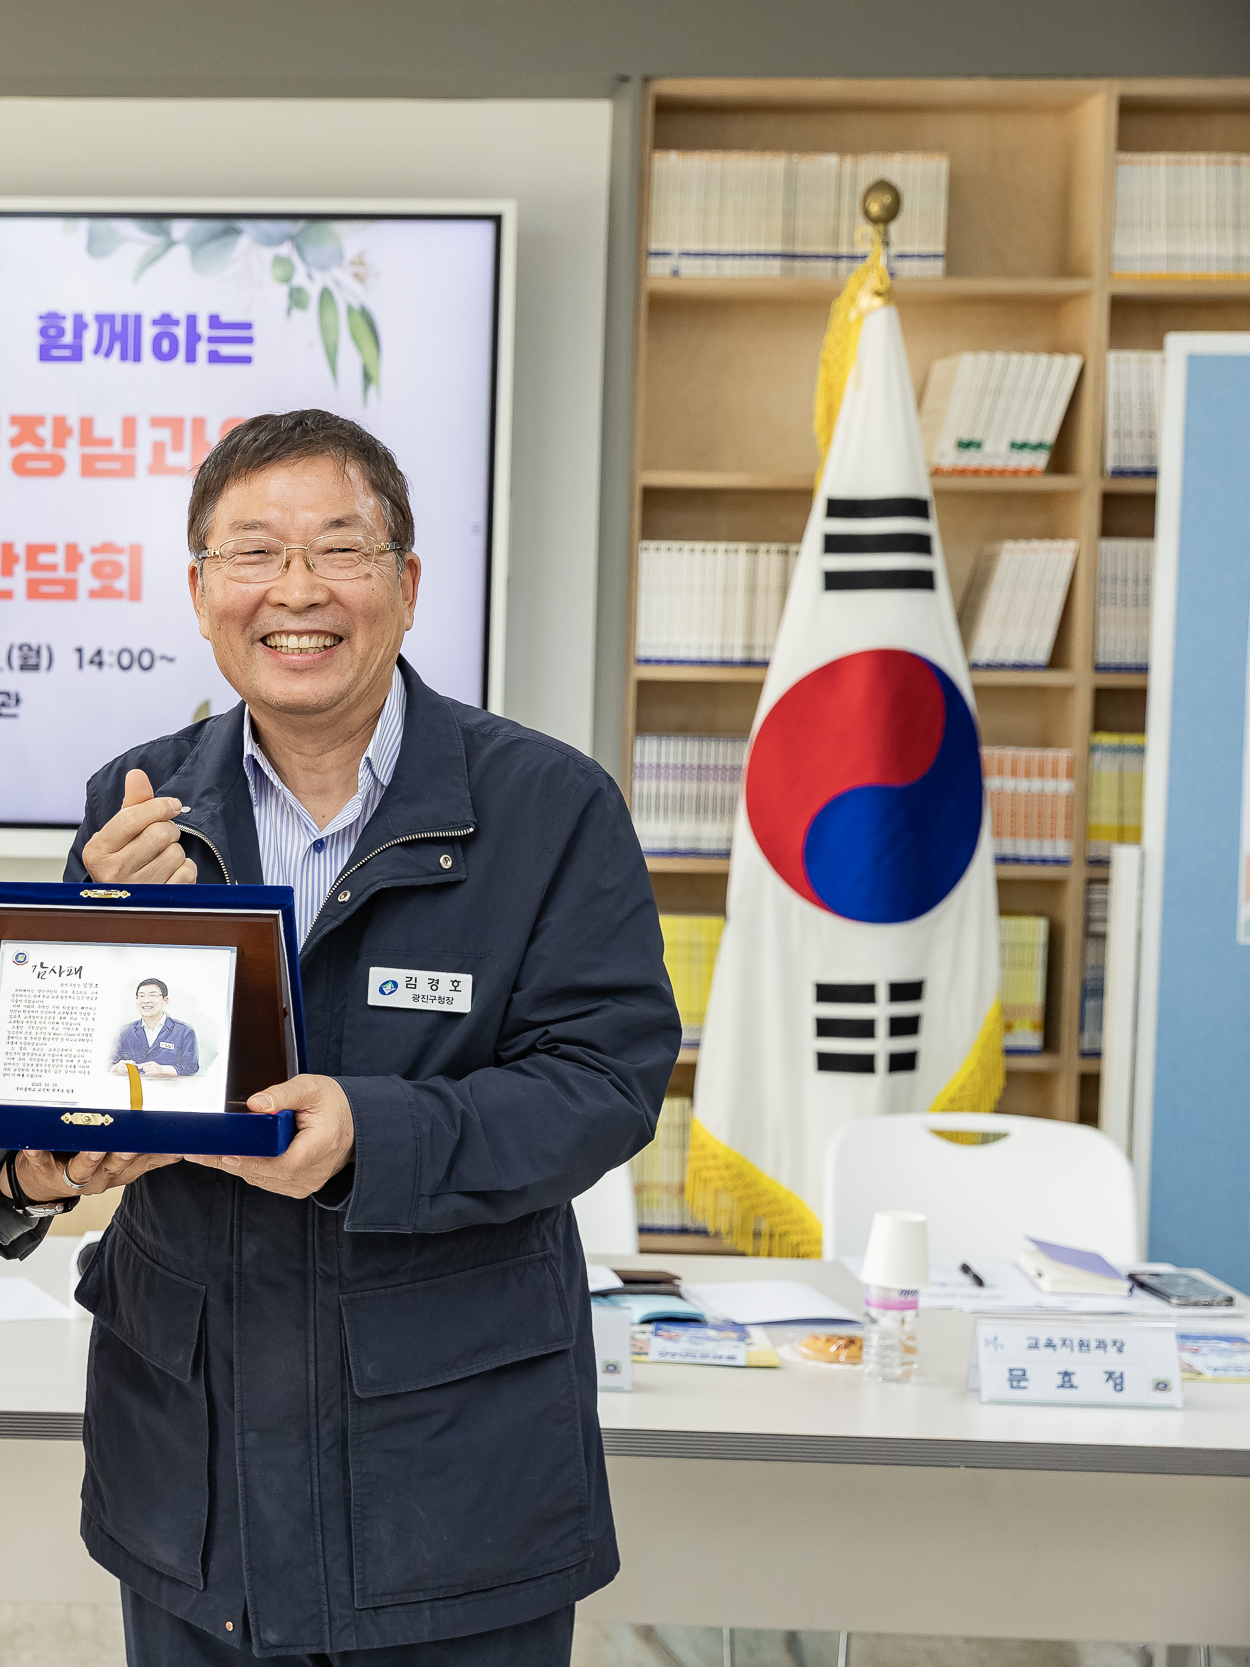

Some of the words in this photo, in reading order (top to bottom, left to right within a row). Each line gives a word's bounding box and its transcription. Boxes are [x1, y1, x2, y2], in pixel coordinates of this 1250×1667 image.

[39, 312, 254, 363] 함께하는
[74, 646, 177, 671] 14:00~
[31, 961, 84, 980] 감사패
[412, 993, 455, 1006] 광진구청장
[1026, 1336, 1125, 1353] 교육지원과장
